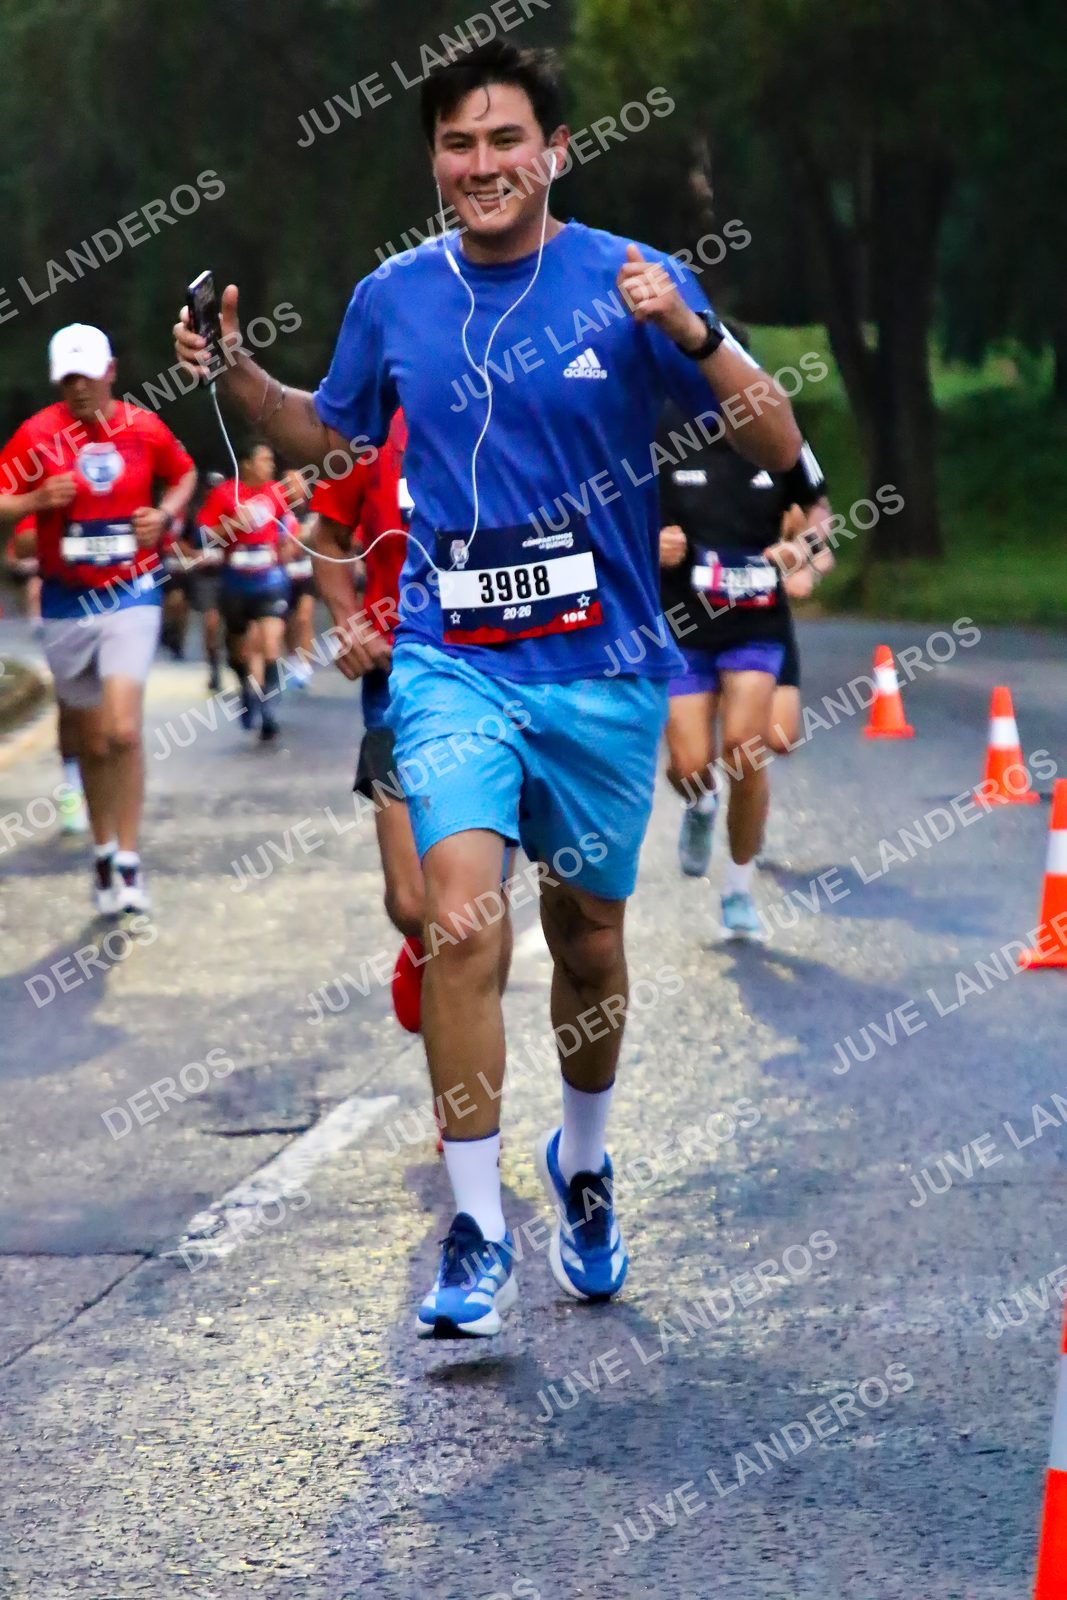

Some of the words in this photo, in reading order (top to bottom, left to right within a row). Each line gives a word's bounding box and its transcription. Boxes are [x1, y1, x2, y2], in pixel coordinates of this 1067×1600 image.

[563, 368, 607, 379] adidas
[478, 565, 550, 604] 3988
[562, 610, 587, 624] 10K
